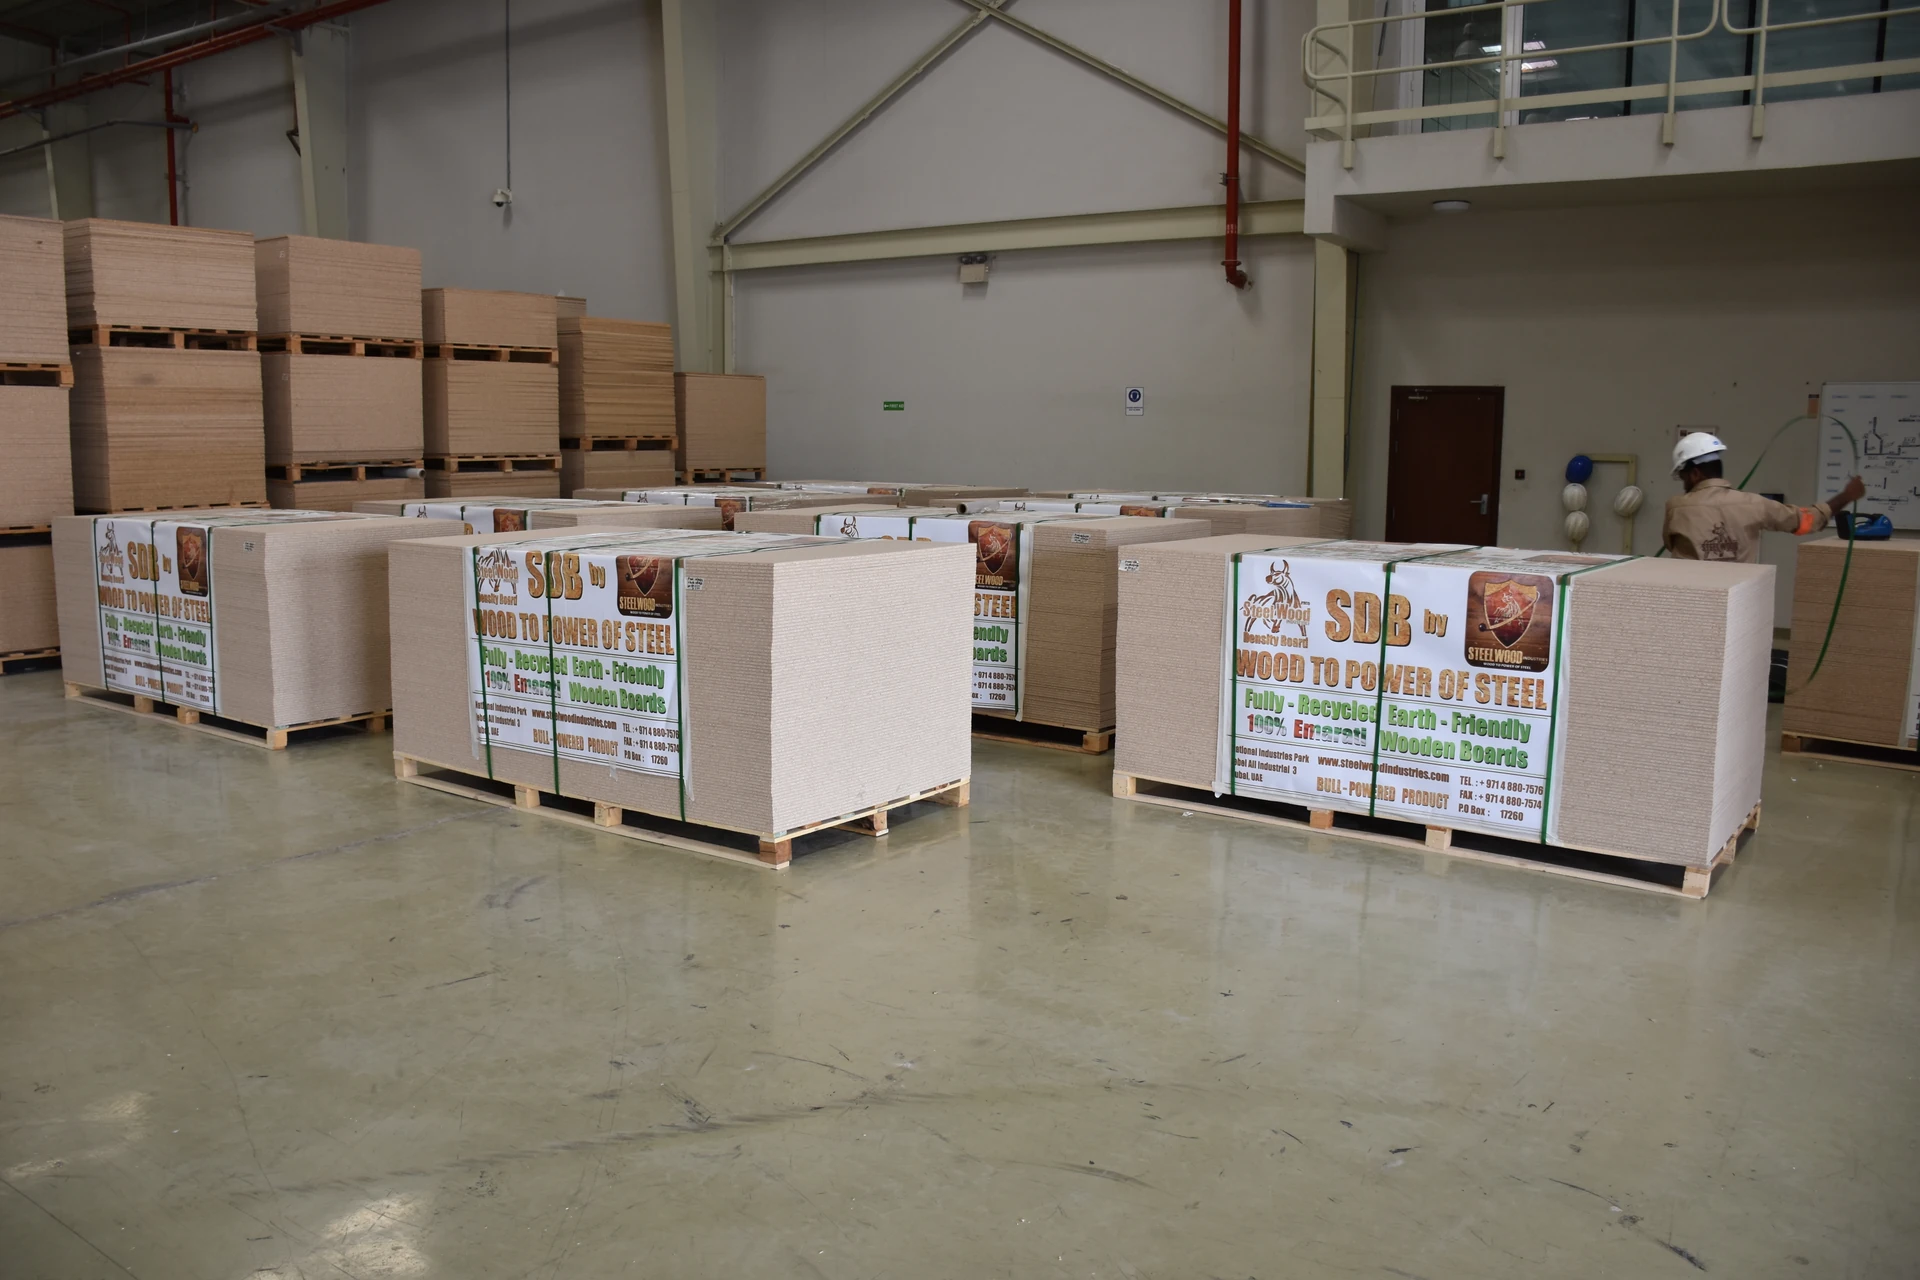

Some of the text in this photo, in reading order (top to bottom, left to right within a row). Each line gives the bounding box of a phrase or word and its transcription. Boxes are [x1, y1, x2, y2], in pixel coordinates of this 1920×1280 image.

[162, 553, 171, 574] by
[495, 563, 518, 579] Wood
[525, 550, 606, 600] SDB by
[976, 574, 1003, 585] EELWOOD
[99, 585, 211, 623] WOOD TO POWER OF STEEL
[500, 593, 517, 606] Board
[619, 596, 656, 611] STEELWOOD
[1243, 601, 1311, 622] Steel Wood
[1325, 588, 1449, 647] SDB by
[123, 616, 154, 636] Recycled
[157, 621, 173, 640] arth
[178, 624, 207, 647] Friendly
[472, 608, 675, 656] WOOD TO POWER OF STEEL
[973, 625, 1009, 644] endly
[1243, 631, 1308, 648] Density Board
[973, 646, 1007, 662] ards
[1468, 646, 1523, 664] STEELWOOD
[483, 645, 507, 670] Fully
[515, 649, 568, 676] Recyced
[572, 656, 603, 681] Earth
[612, 661, 665, 689] Friendly
[978, 671, 987, 679] 971
[993, 672, 1015, 681] 880-757
[1236, 649, 1547, 710] WOOD TO POWER OF STEEL
[485, 670, 667, 714] 100% Emarai Wooden Boards
[993, 682, 1015, 691] 880-757
[989, 693, 1006, 701] 17260
[475, 701, 527, 716] Natinal Industries Park
[1245, 688, 1285, 715] Fully
[1298, 694, 1378, 724] Recycled
[1388, 704, 1436, 731] Earth
[1451, 711, 1532, 743] Friendly
[517, 719, 520, 727] 3
[532, 709, 617, 730] www.stelwoodindustries.com
[491, 727, 500, 736] UAE
[639, 726, 648, 736] 971
[648, 728, 652, 737] 4
[587, 737, 618, 757] PRODUCT
[624, 736, 632, 747] FAX
[640, 740, 648, 749] 971
[649, 741, 653, 750] 4
[1246, 713, 1528, 769] 100% Emarati Wooden Boards
[651, 755, 668, 765] 17260
[1236, 746, 1310, 763] ational Industries Park
[1235, 758, 1297, 775] ebel Ali Industrial 3
[1235, 771, 1263, 782] ubai, UAE
[1486, 779, 1499, 789] 971
[1500, 781, 1505, 790] 4
[1507, 782, 1544, 795] 880-7576
[1402, 788, 1450, 810] PRODUCT
[1460, 790, 1473, 800] FAX
[1485, 793, 1498, 804] 971
[1499, 795, 1504, 804] 4
[1506, 796, 1542, 809] 880-7574
[1459, 803, 1469, 813] P.O
[1500, 809, 1523, 821] 17260
